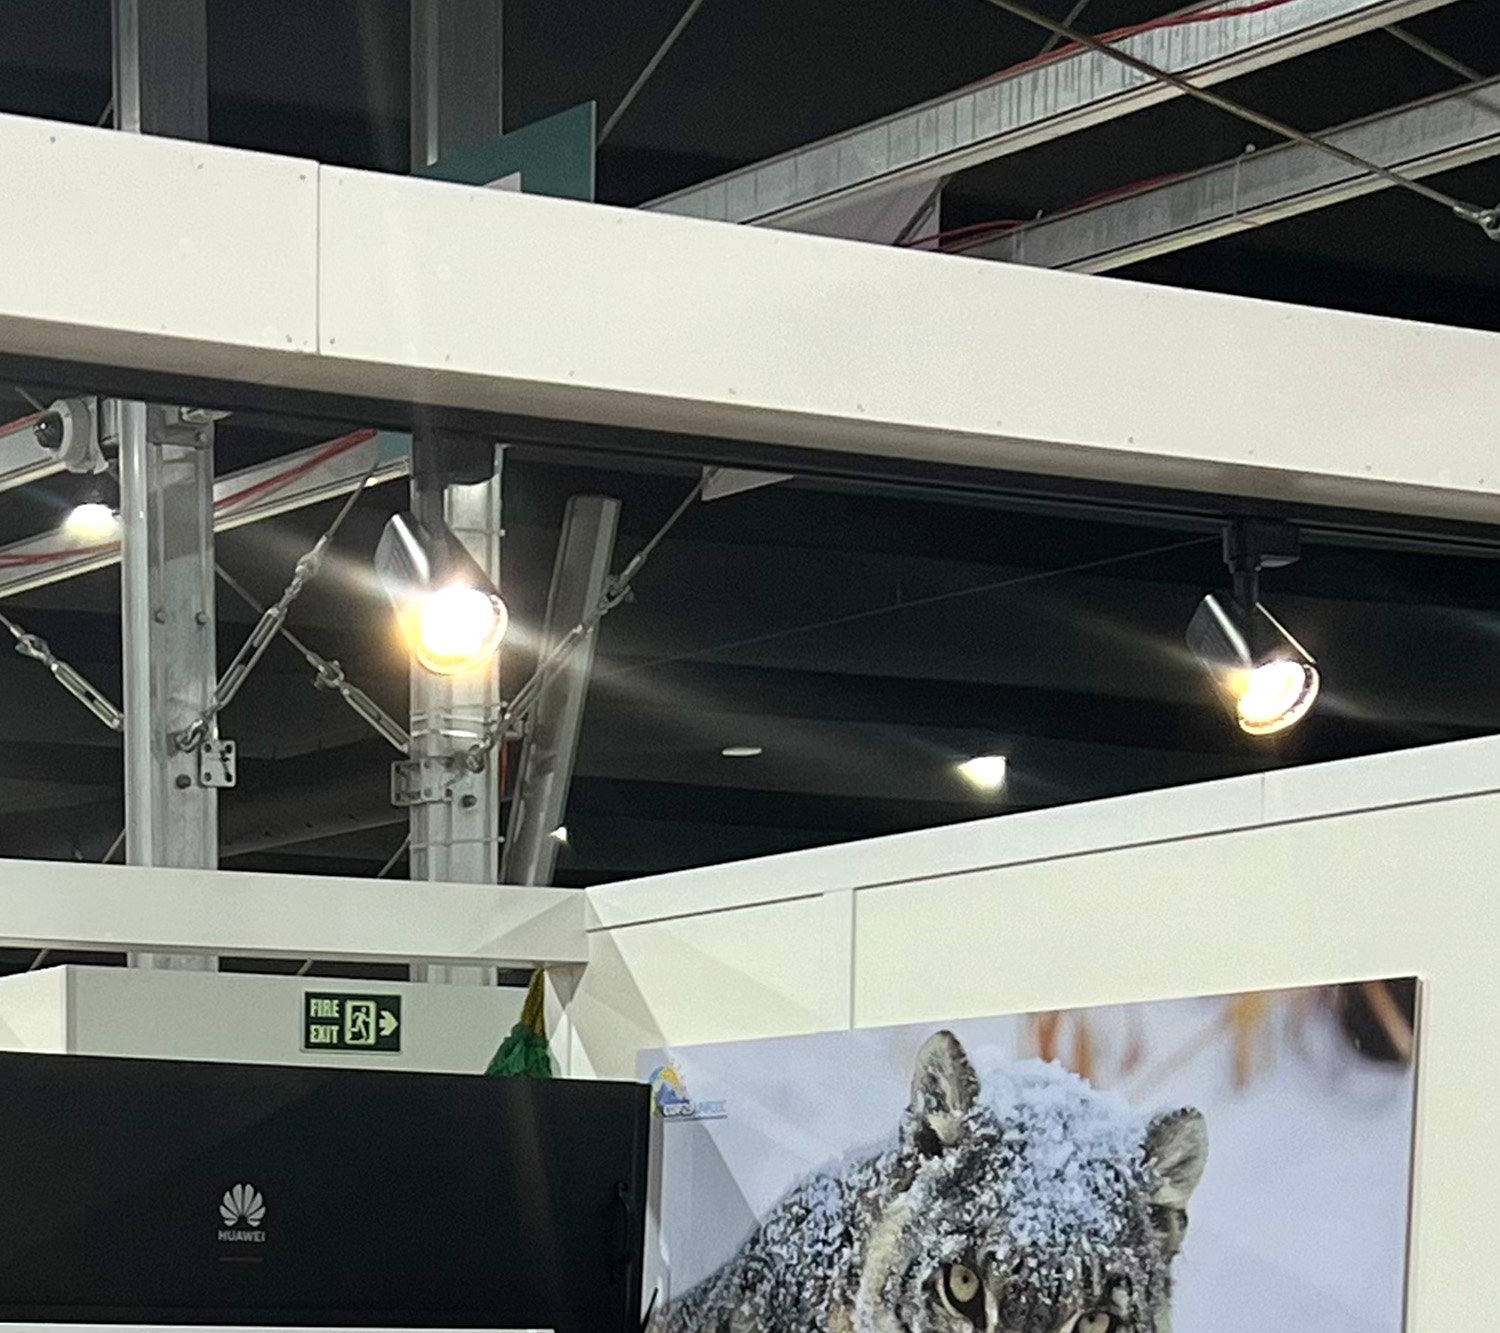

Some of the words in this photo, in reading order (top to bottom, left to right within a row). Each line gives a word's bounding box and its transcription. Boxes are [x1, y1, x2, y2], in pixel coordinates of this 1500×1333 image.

[310, 998, 339, 1017] FIRE
[310, 1025, 339, 1043] EXIT
[218, 1230, 266, 1242] HUAWEI
